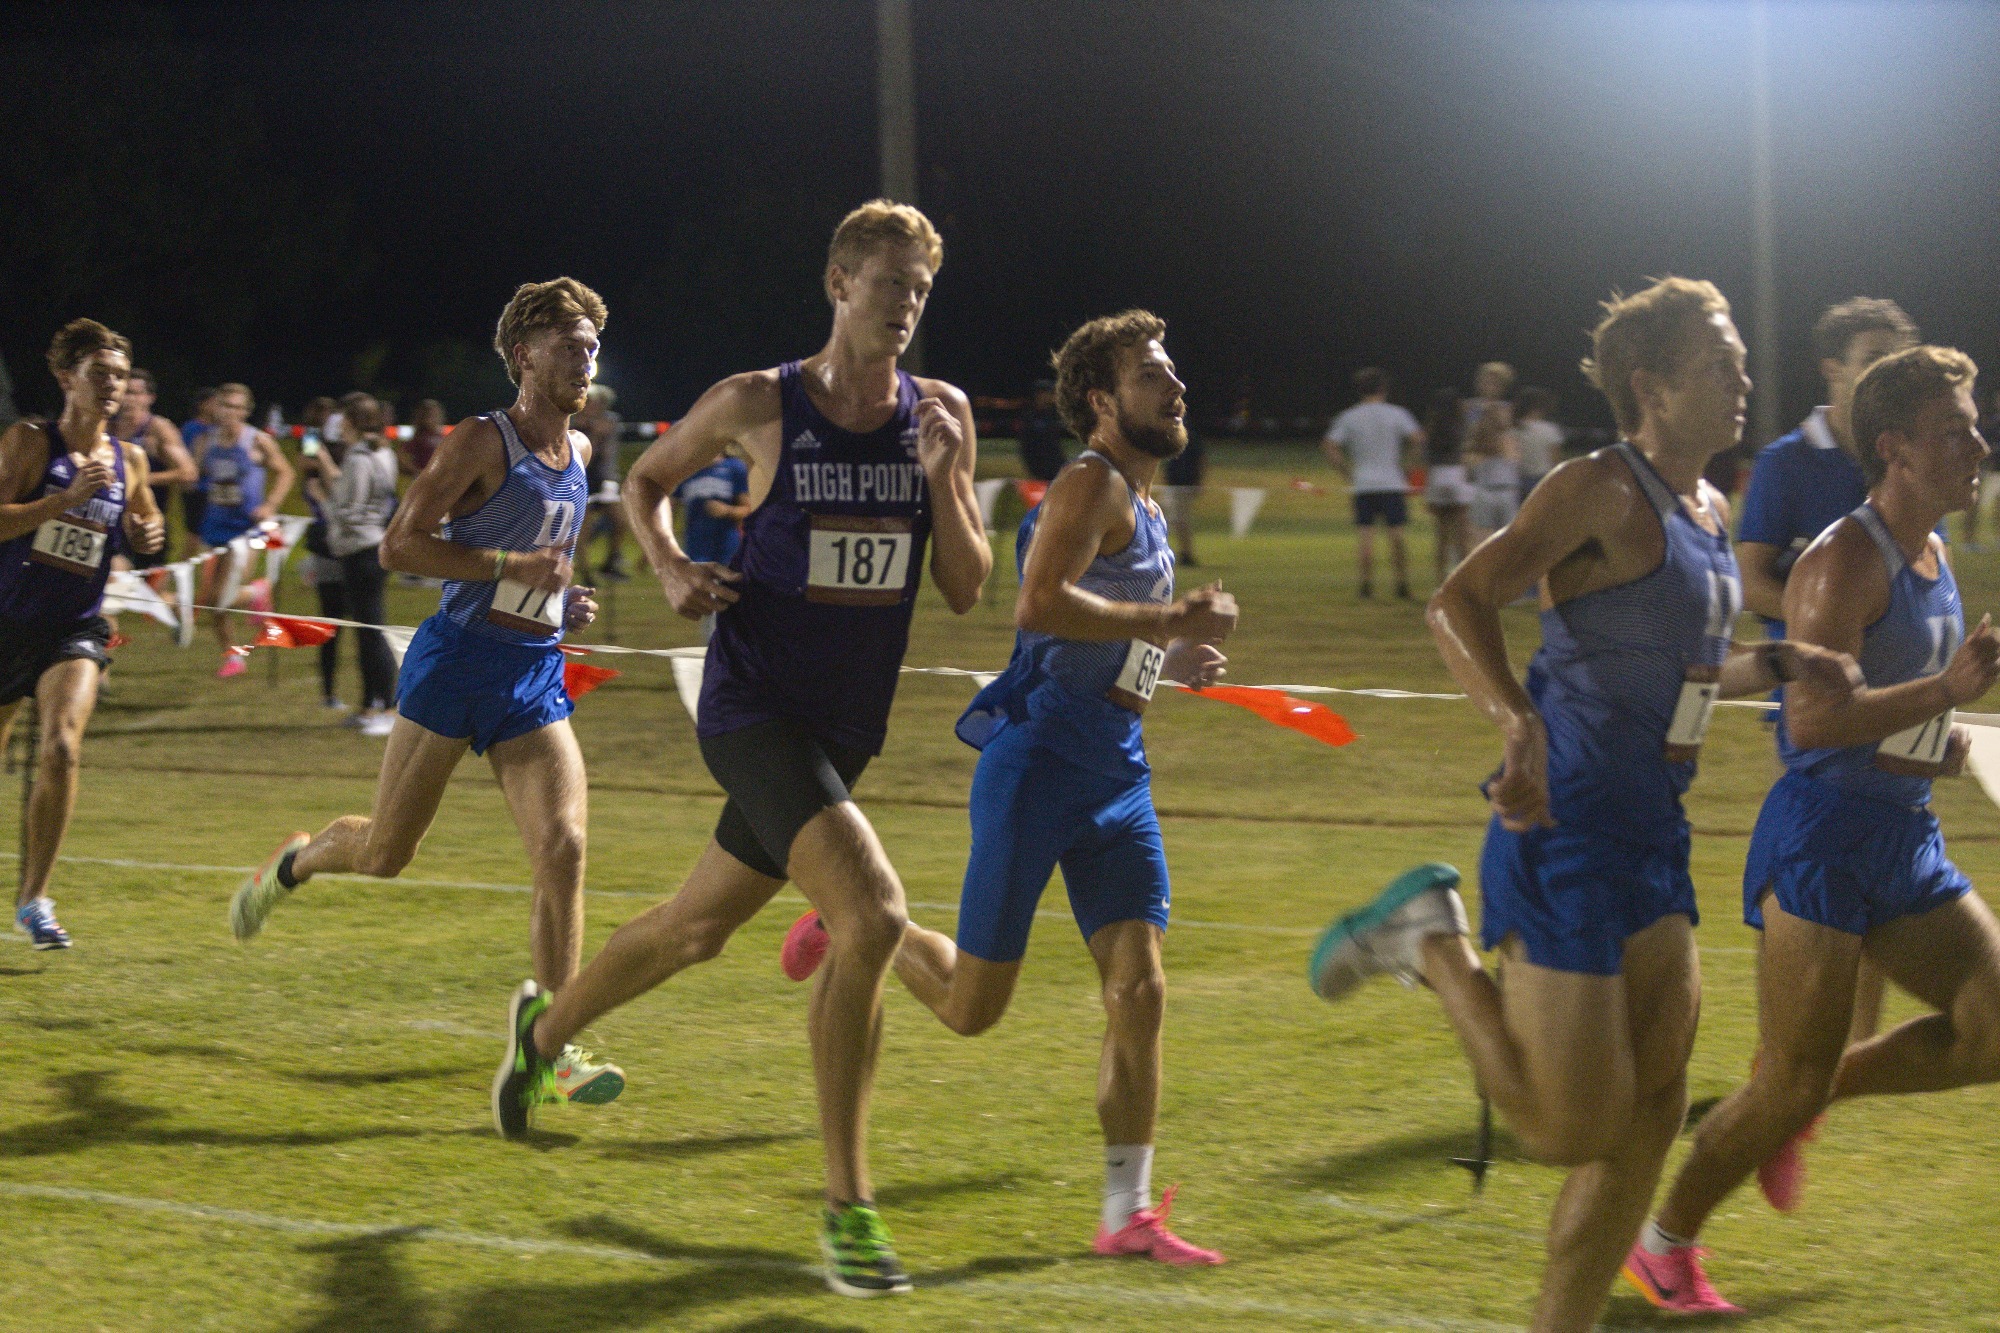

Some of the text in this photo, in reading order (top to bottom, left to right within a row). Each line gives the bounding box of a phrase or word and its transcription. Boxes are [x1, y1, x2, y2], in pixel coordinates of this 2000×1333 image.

[793, 463, 924, 502] HIGH POINT
[50, 525, 93, 561] 189
[831, 536, 897, 585] 187
